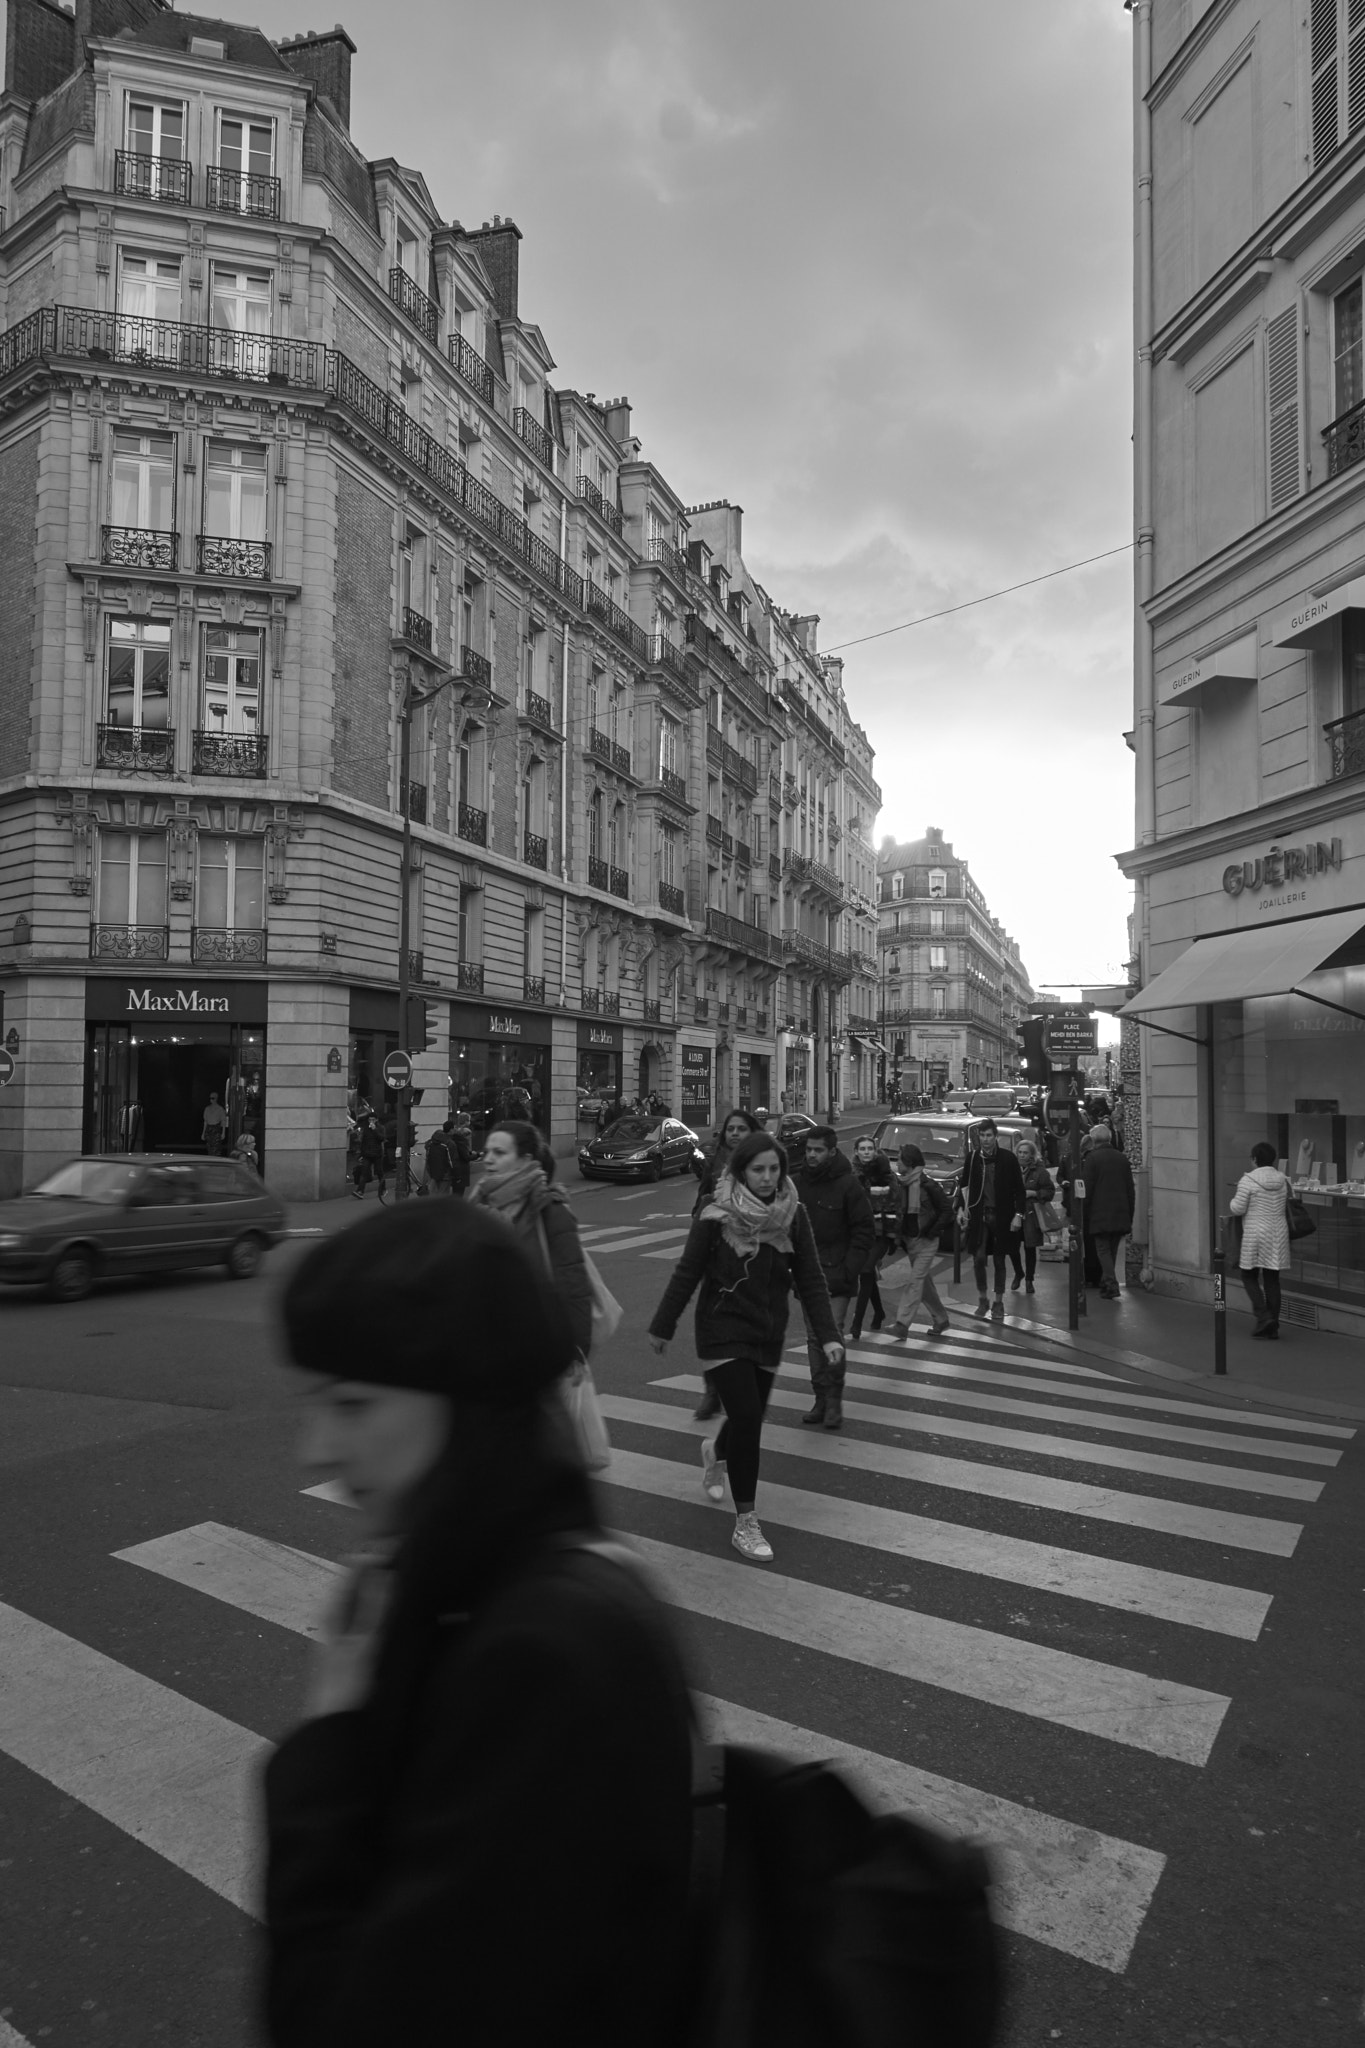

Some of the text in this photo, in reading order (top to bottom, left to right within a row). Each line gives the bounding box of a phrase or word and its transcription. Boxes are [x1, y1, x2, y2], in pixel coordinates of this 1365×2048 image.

[1291, 600, 1329, 629] GUÉRIN
[1223, 837, 1342, 896] GUÉRIN
[1258, 891, 1307, 910] JOAILLERIE
[126, 988, 229, 1012] MaxMara
